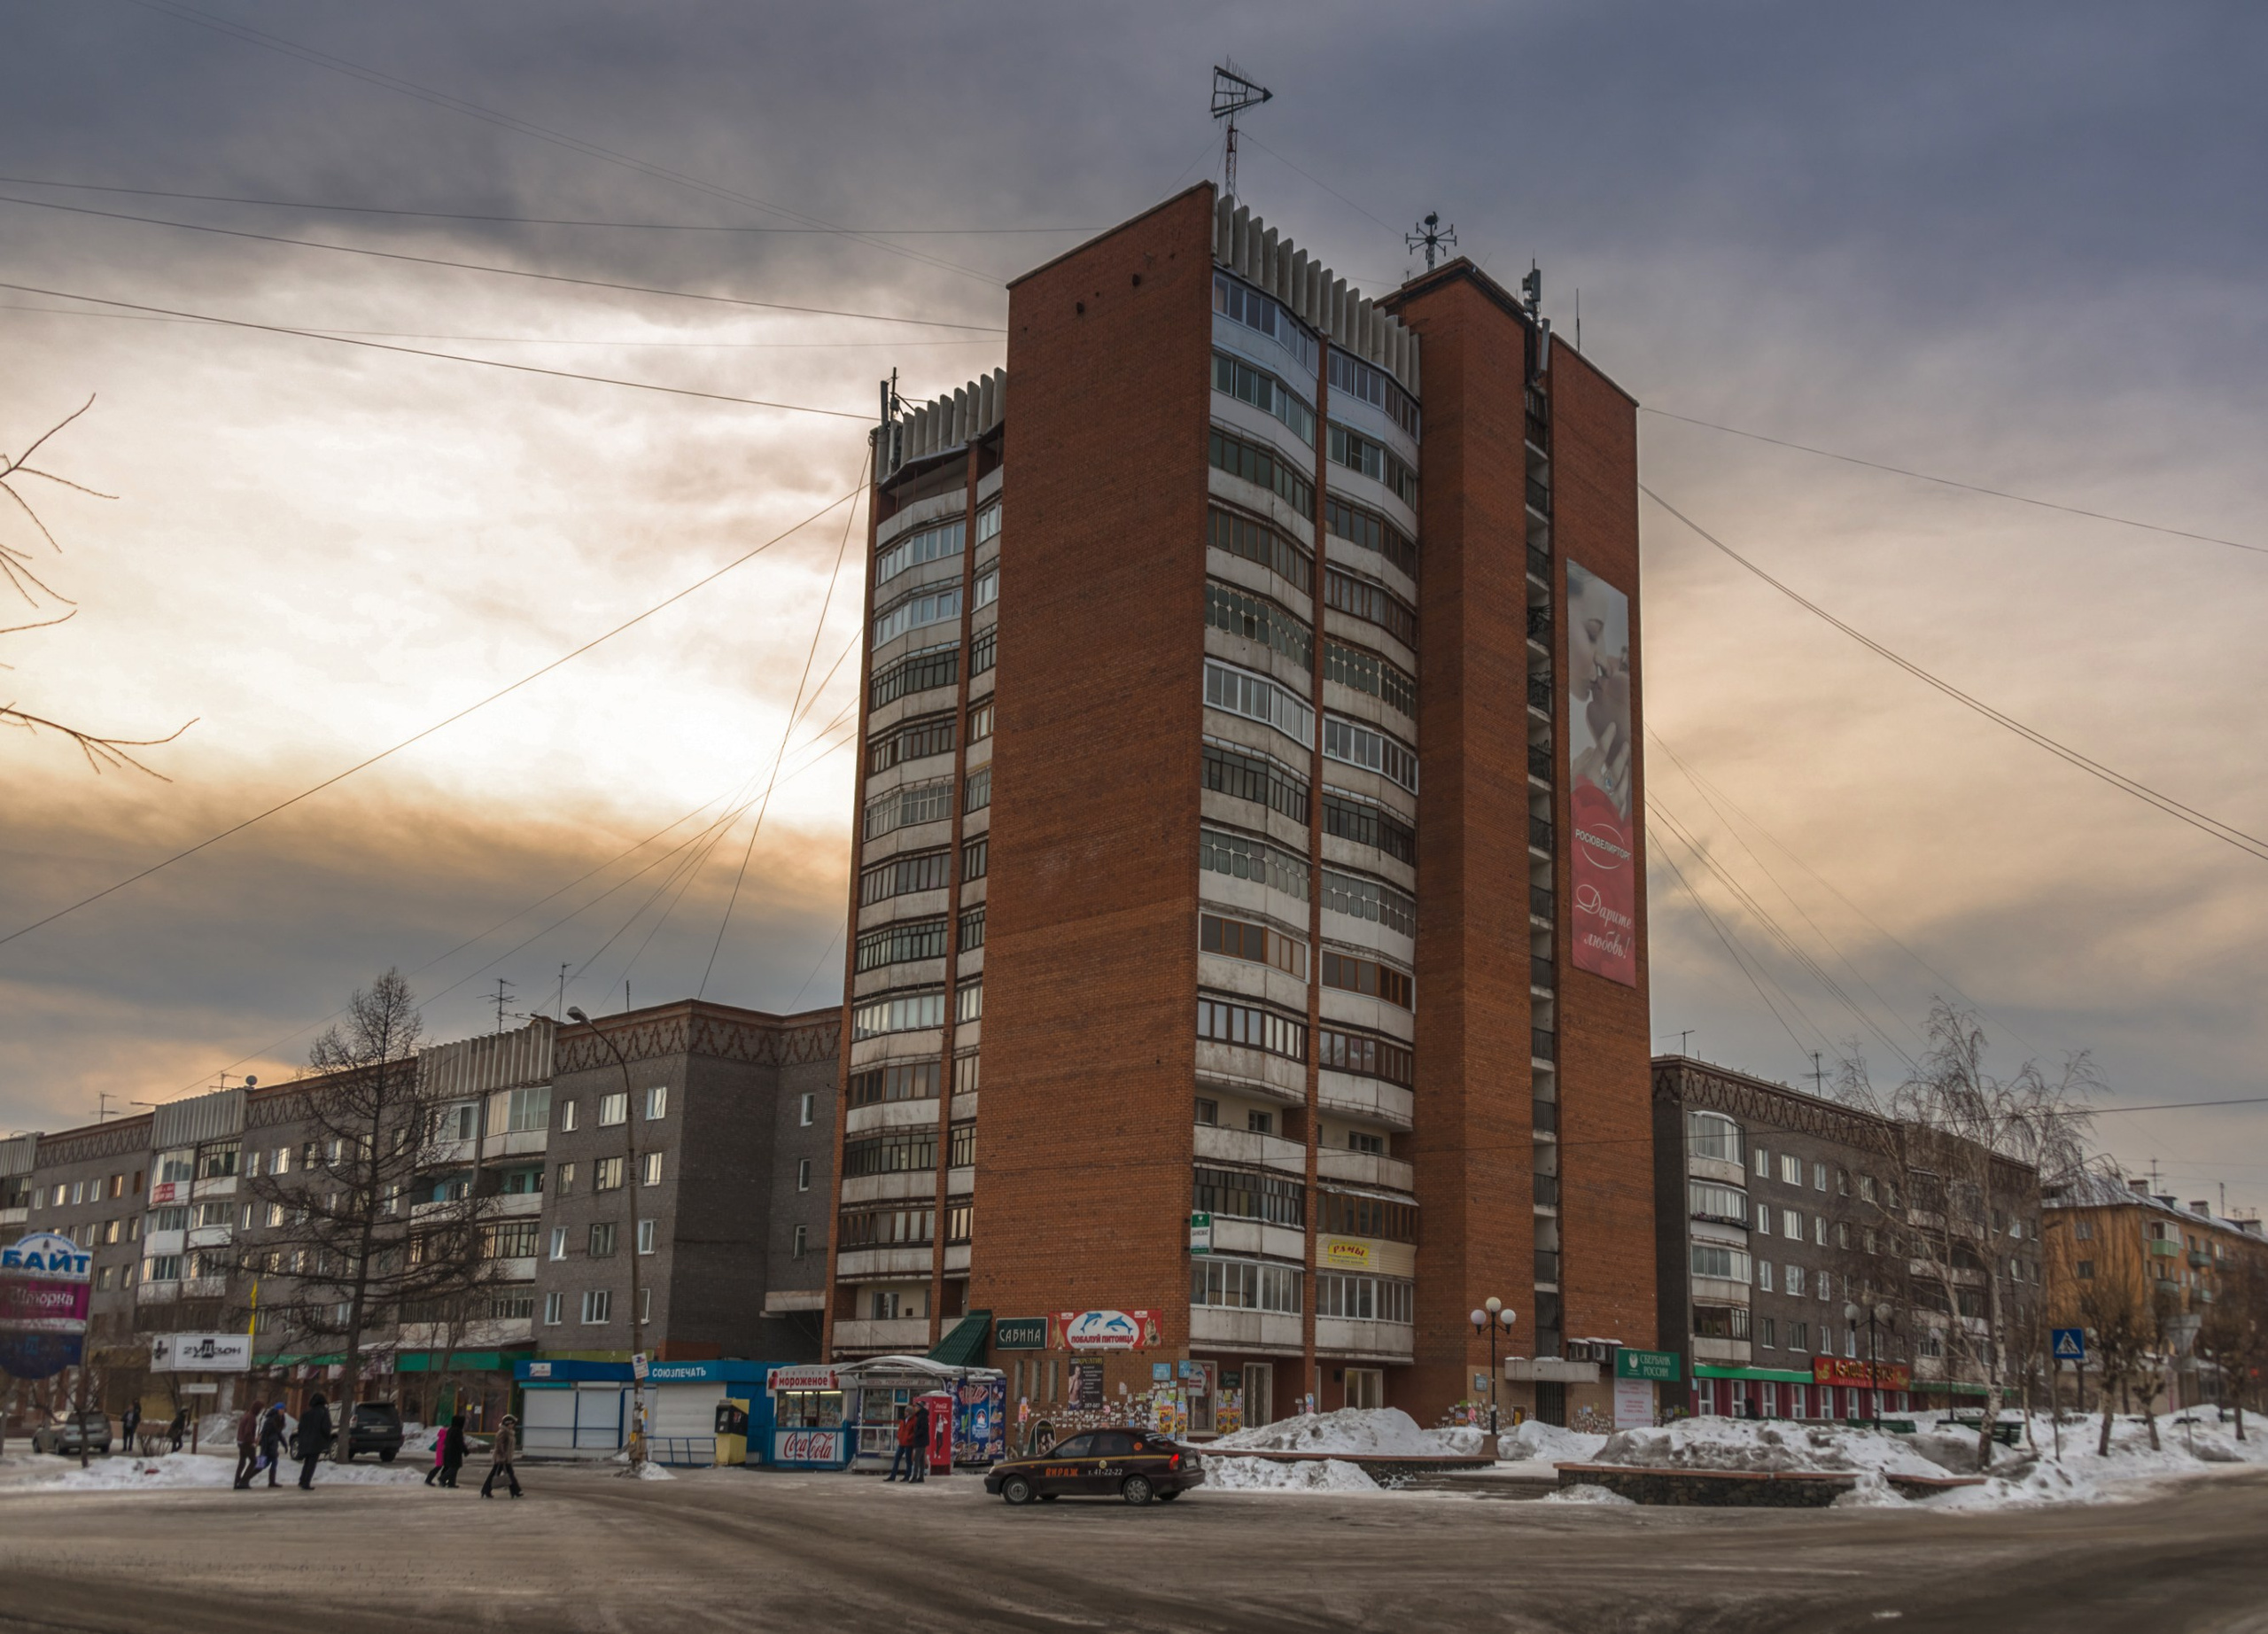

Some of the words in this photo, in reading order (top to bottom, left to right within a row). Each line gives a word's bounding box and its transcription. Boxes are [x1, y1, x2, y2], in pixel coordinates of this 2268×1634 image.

[1575, 829, 1632, 861] РОСЮВЕЛИРТОРГ
[1575, 883, 1632, 930] Дарите
[1583, 930, 1631, 960] любовь!
[2, 1249, 91, 1274] БАЙТ
[998, 1328, 1041, 1343] САБИНА
[1071, 1333, 1101, 1343] ПОБАЛУЙ
[1101, 1334, 1134, 1345] ПИТОМЦА
[1639, 1354, 1671, 1366] СБЕРБАНК
[652, 1366, 707, 1378] СОЮЗПЕЧАТЬ
[1643, 1366, 1669, 1377] РОССИИ
[779, 1376, 828, 1389] мороженое
[1045, 1467, 1078, 1477] ВИРАЖ
